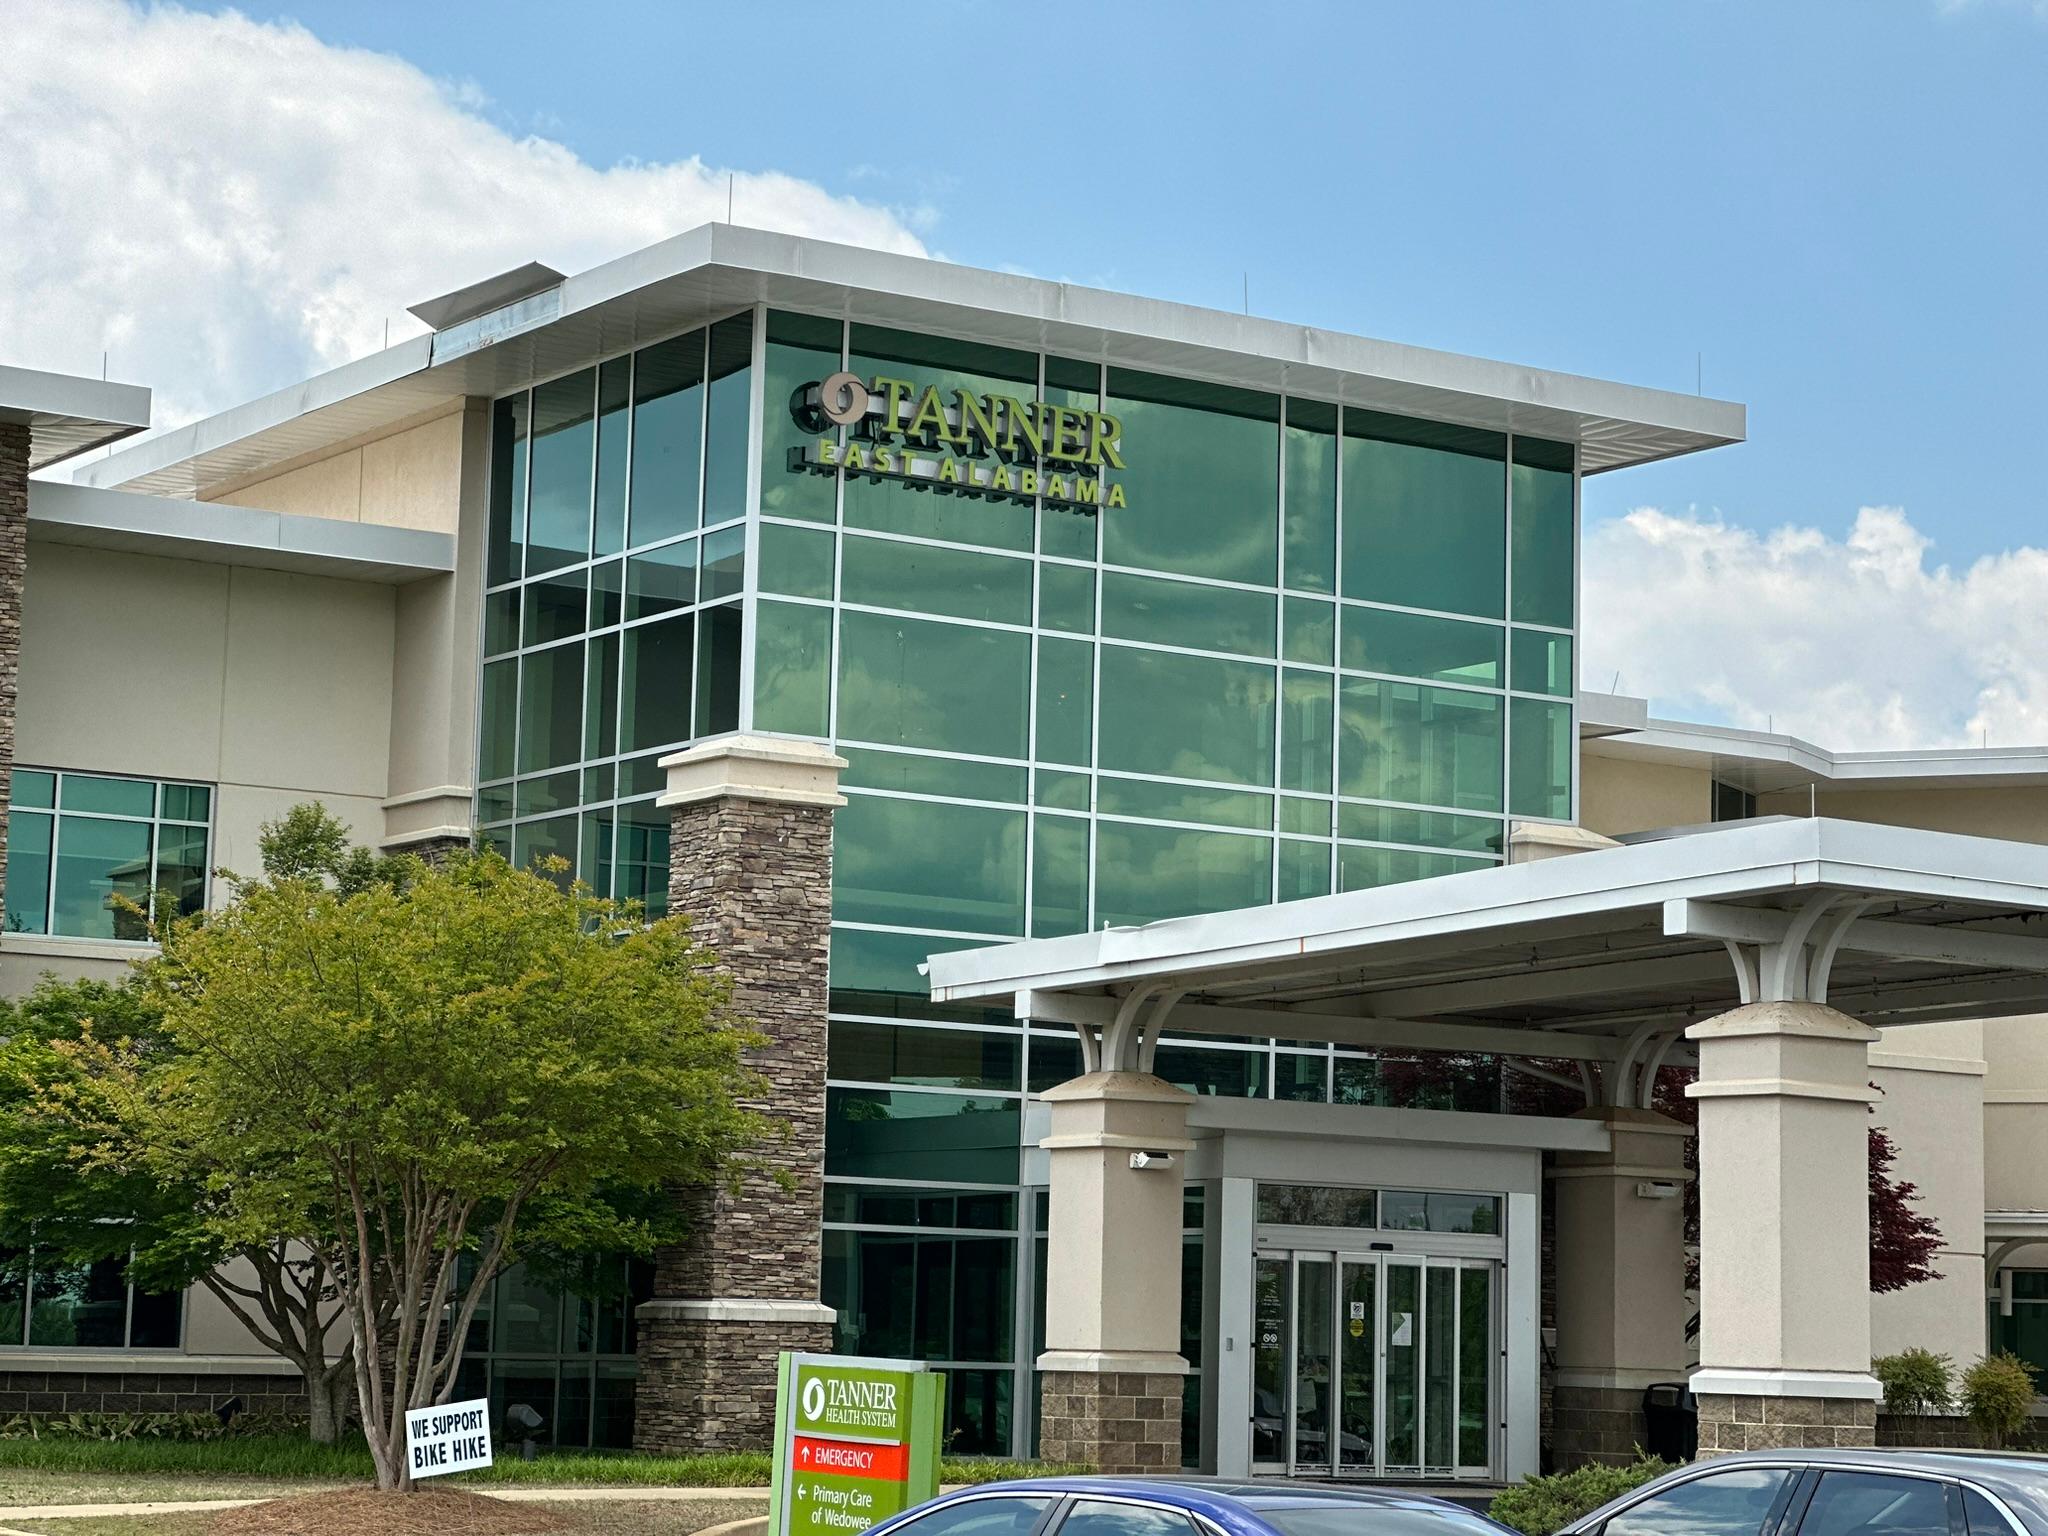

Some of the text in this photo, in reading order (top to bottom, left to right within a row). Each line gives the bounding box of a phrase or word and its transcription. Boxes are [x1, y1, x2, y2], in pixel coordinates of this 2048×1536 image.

[869, 376, 1126, 469] TANNER
[818, 438, 1126, 509] EAST ALABAMA
[827, 1379, 897, 1410] TANNER
[411, 1409, 483, 1439] WE SUPPORT
[826, 1407, 896, 1428] HEALTH SYSTEM
[414, 1435, 486, 1469] BIKE HIKE
[815, 1447, 873, 1469] EMERGENCY
[813, 1485, 872, 1508] Primary Care
[811, 1506, 871, 1530] of Wedowee
